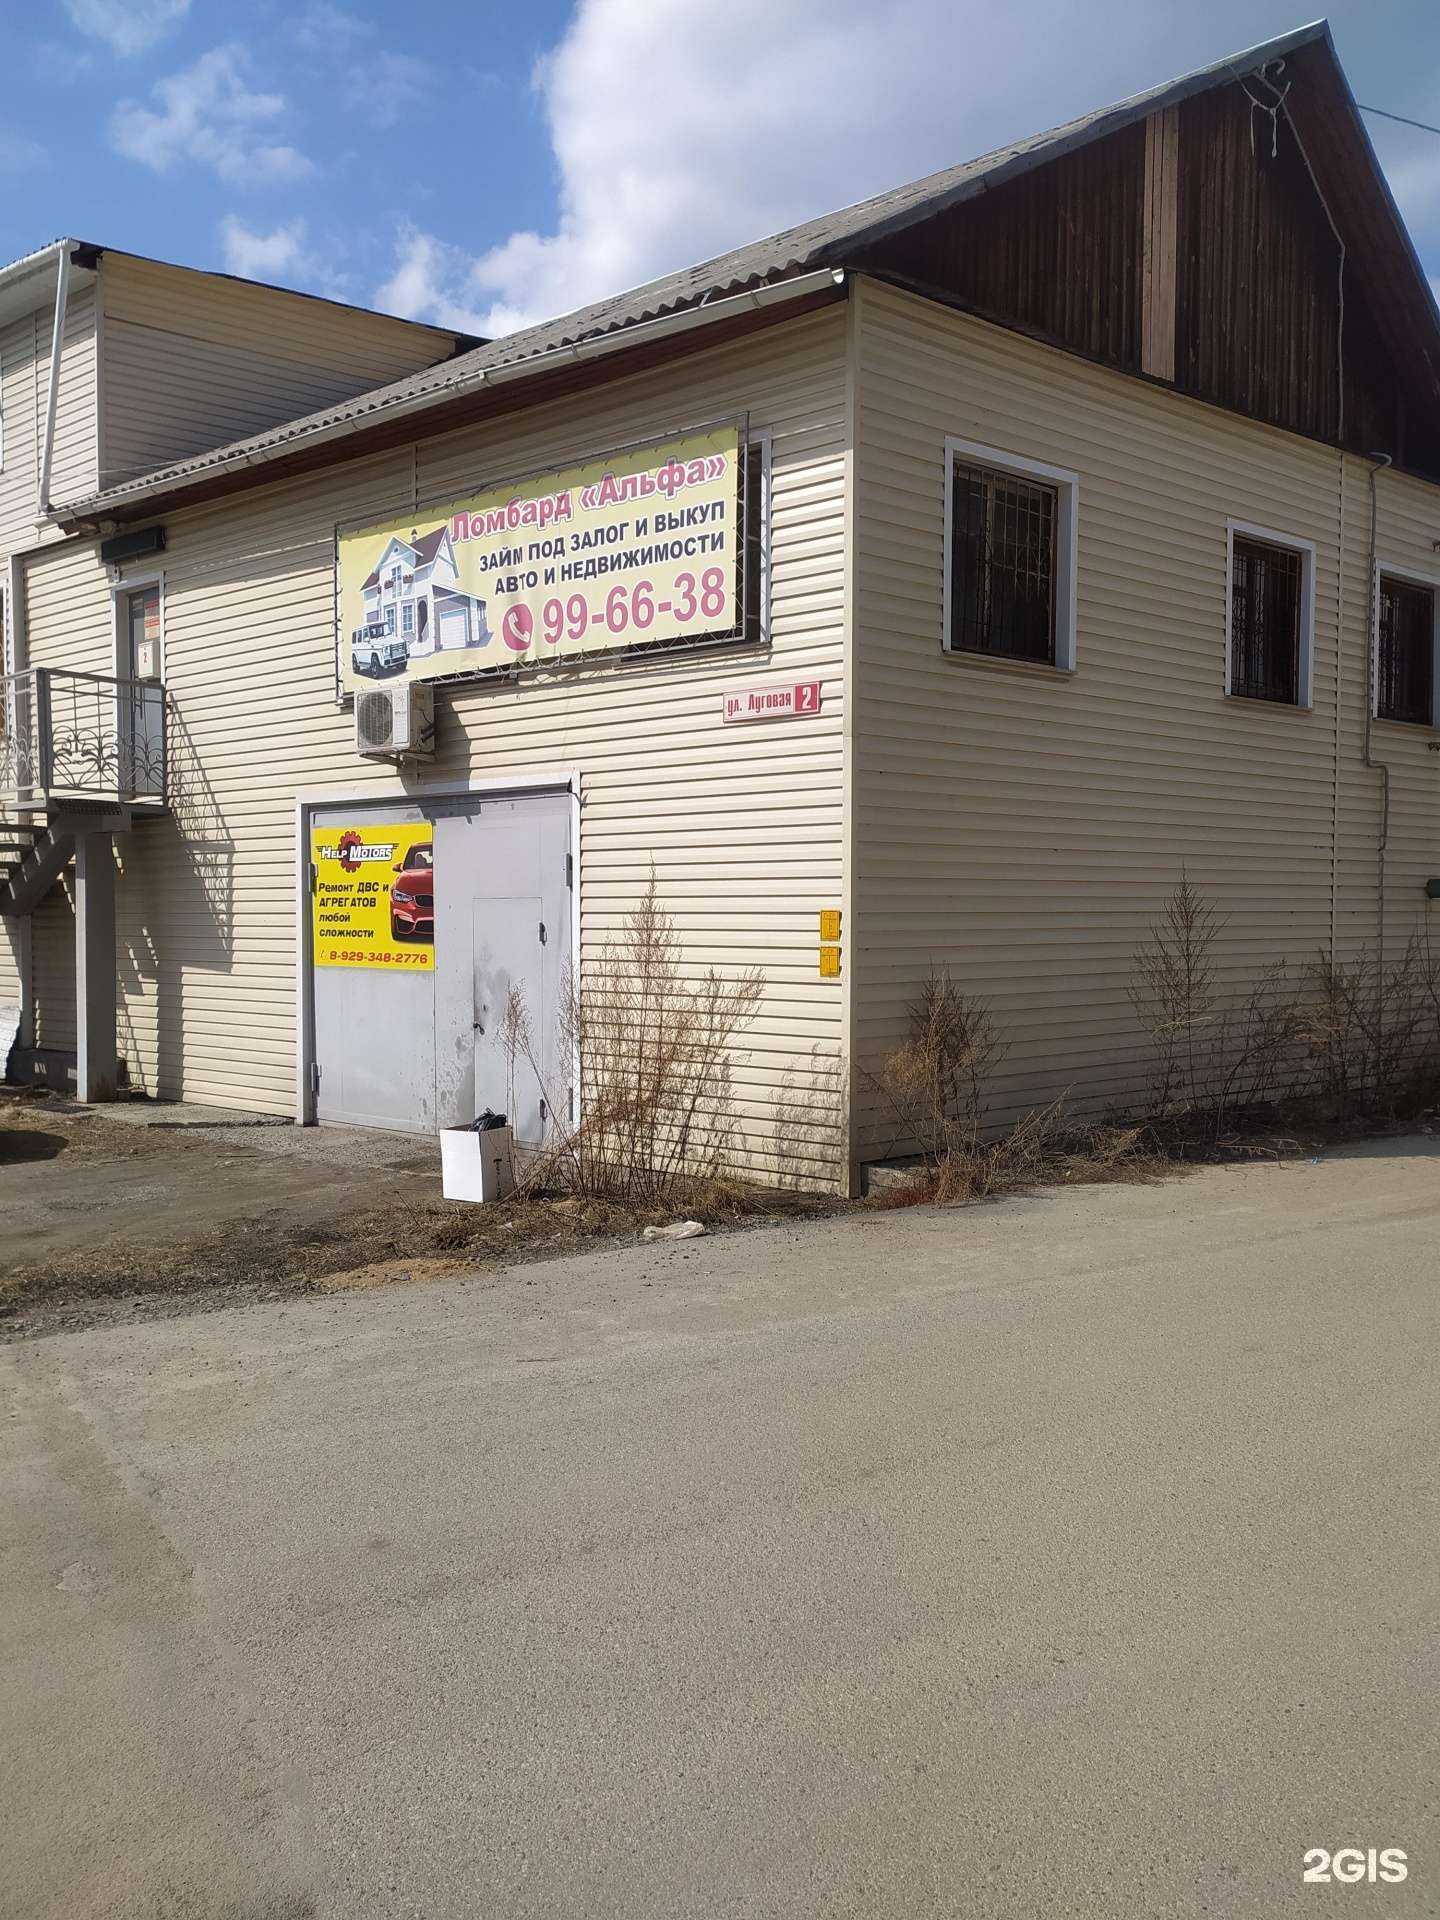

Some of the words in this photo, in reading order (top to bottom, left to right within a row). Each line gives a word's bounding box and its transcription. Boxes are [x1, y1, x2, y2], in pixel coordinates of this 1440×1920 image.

[450, 495, 573, 545] Ломбард
[579, 455, 728, 512] «Альфа»
[479, 546, 525, 572] ЗАЙМ
[528, 538, 566, 562] ПОД
[570, 522, 629, 552] ЗАЛОГ
[635, 518, 649, 537] И
[655, 500, 726, 532] ВЫКУП
[495, 570, 538, 596] АВТО
[544, 568, 556, 584] И
[561, 531, 726, 582] НЕДВИЖИМОСТИ
[543, 567, 726, 645] 99-66-38
[727, 699, 743, 716] ул.
[748, 692, 791, 713] Луговая
[802, 686, 812, 710] 2
[318, 882, 354, 893] Ремонт
[357, 882, 380, 894] ДВС
[382, 883, 389, 892] и
[319, 897, 377, 907] АГРЕГАТОВ
[318, 912, 351, 923] любой
[319, 928, 374, 938] сложности
[329, 950, 428, 964] 8-929-348-2776
